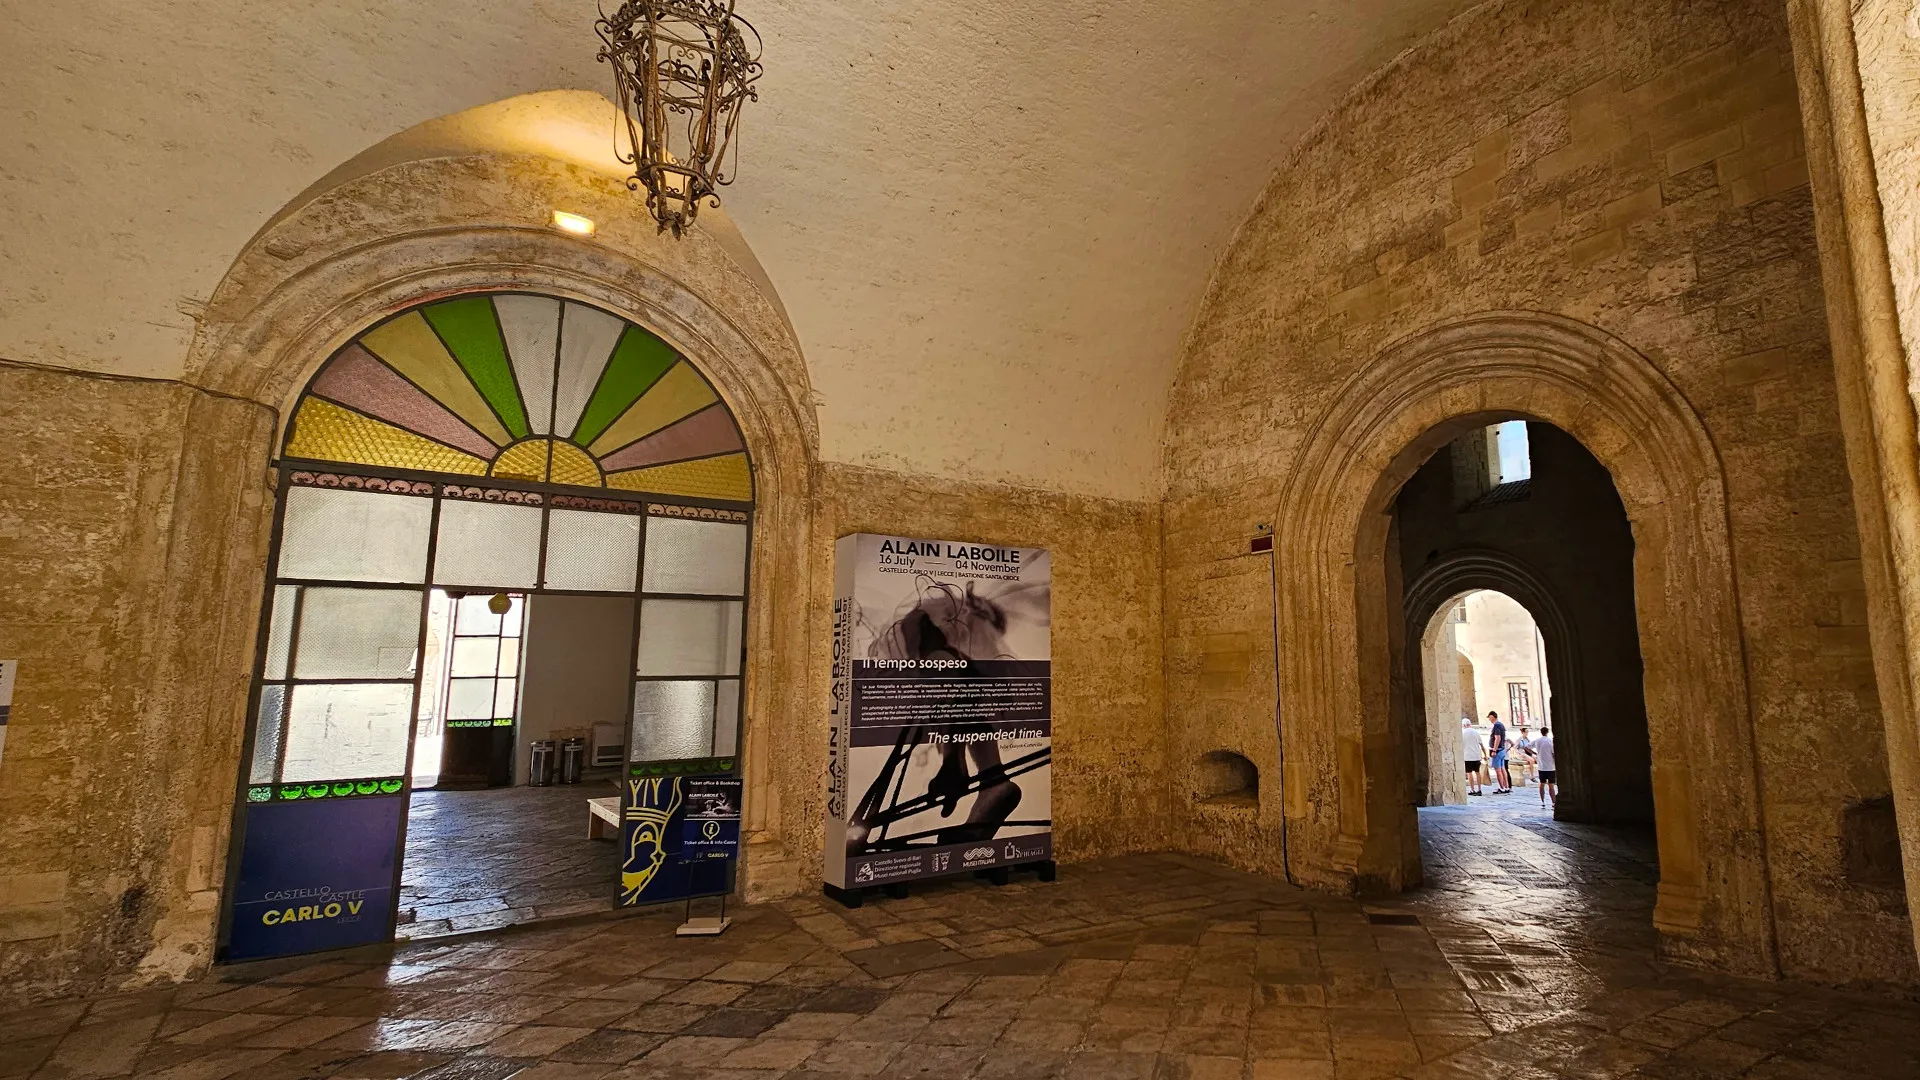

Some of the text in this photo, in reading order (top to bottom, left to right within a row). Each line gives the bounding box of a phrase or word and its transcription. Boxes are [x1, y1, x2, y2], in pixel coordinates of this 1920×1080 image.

[879, 539, 1020, 564] ALAIN LABOILE
[878, 554, 1021, 573] 16 July 04 November
[878, 566, 908, 574] CASTELLO
[1003, 574, 1020, 582] CROCE
[839, 597, 848, 677] November
[862, 657, 968, 671] Il tempo sospeso
[839, 682, 845, 701] 04
[827, 598, 843, 818] ALAIN LABOILE
[927, 728, 1043, 745] The suspended time
[835, 764, 843, 797] July
[264, 885, 331, 901] CASTELLO
[319, 890, 366, 903] CASTLE
[262, 900, 364, 926] CARLO V
